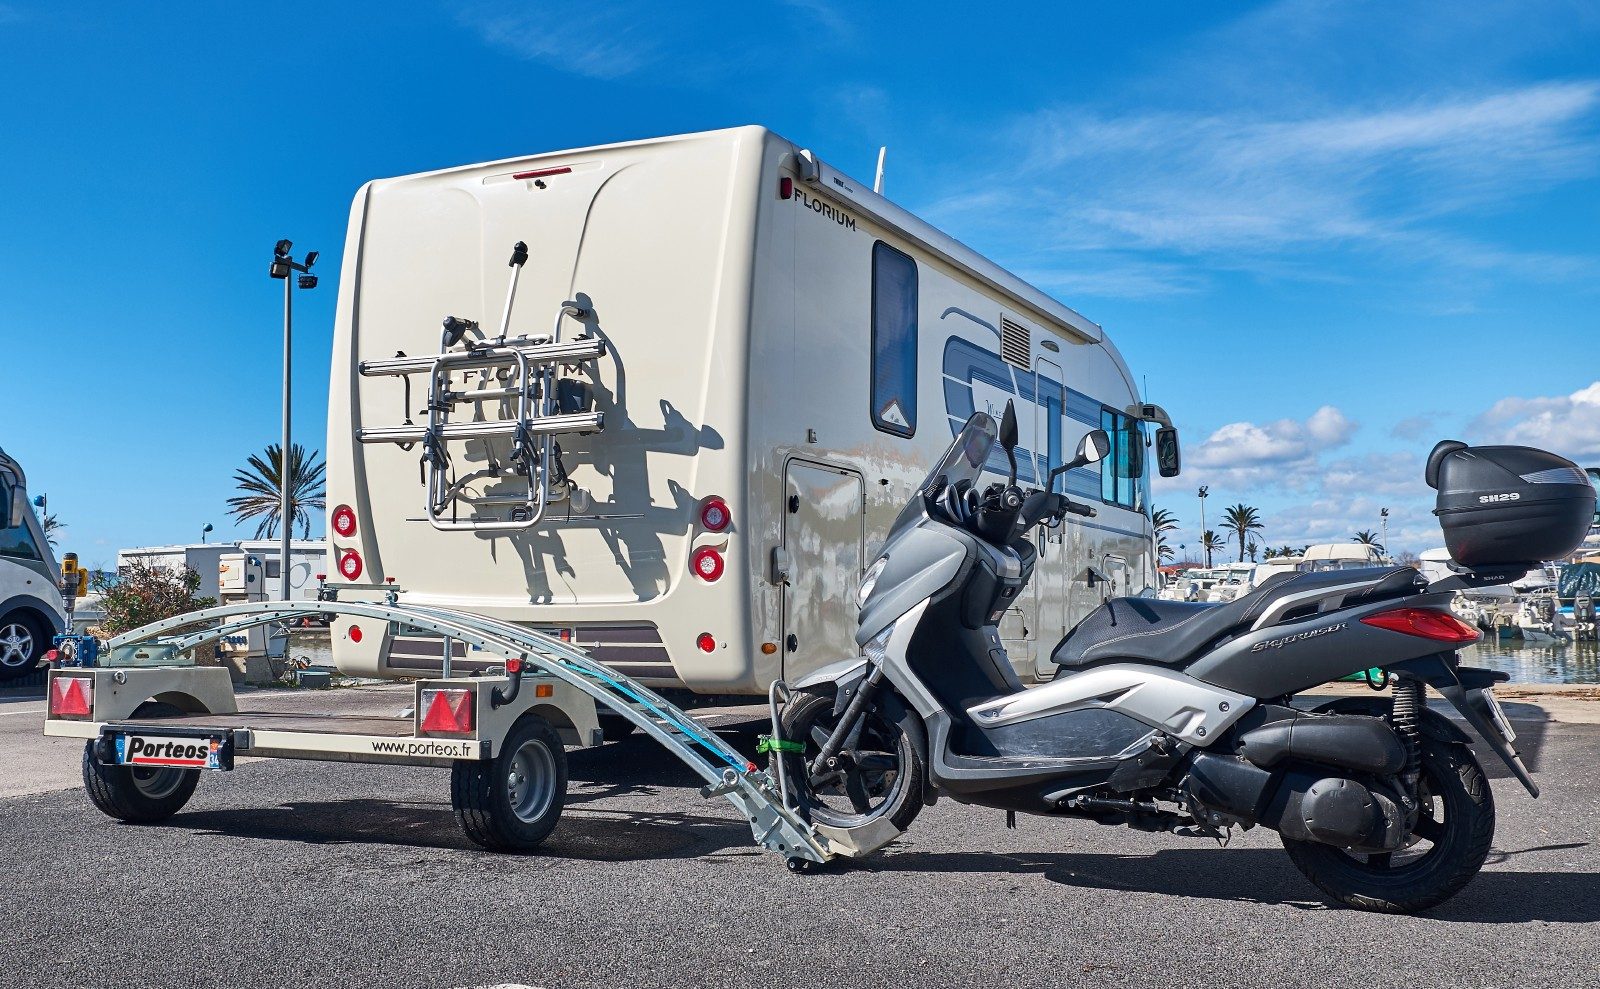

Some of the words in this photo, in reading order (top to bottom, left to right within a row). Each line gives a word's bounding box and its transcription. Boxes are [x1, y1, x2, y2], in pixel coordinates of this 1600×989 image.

[794, 187, 857, 232] FLORIUM
[1478, 492, 1521, 504] SH29
[126, 737, 209, 762] Porteos
[372, 742, 471, 756] www.porteos.fr
[210, 754, 219, 765] 34
